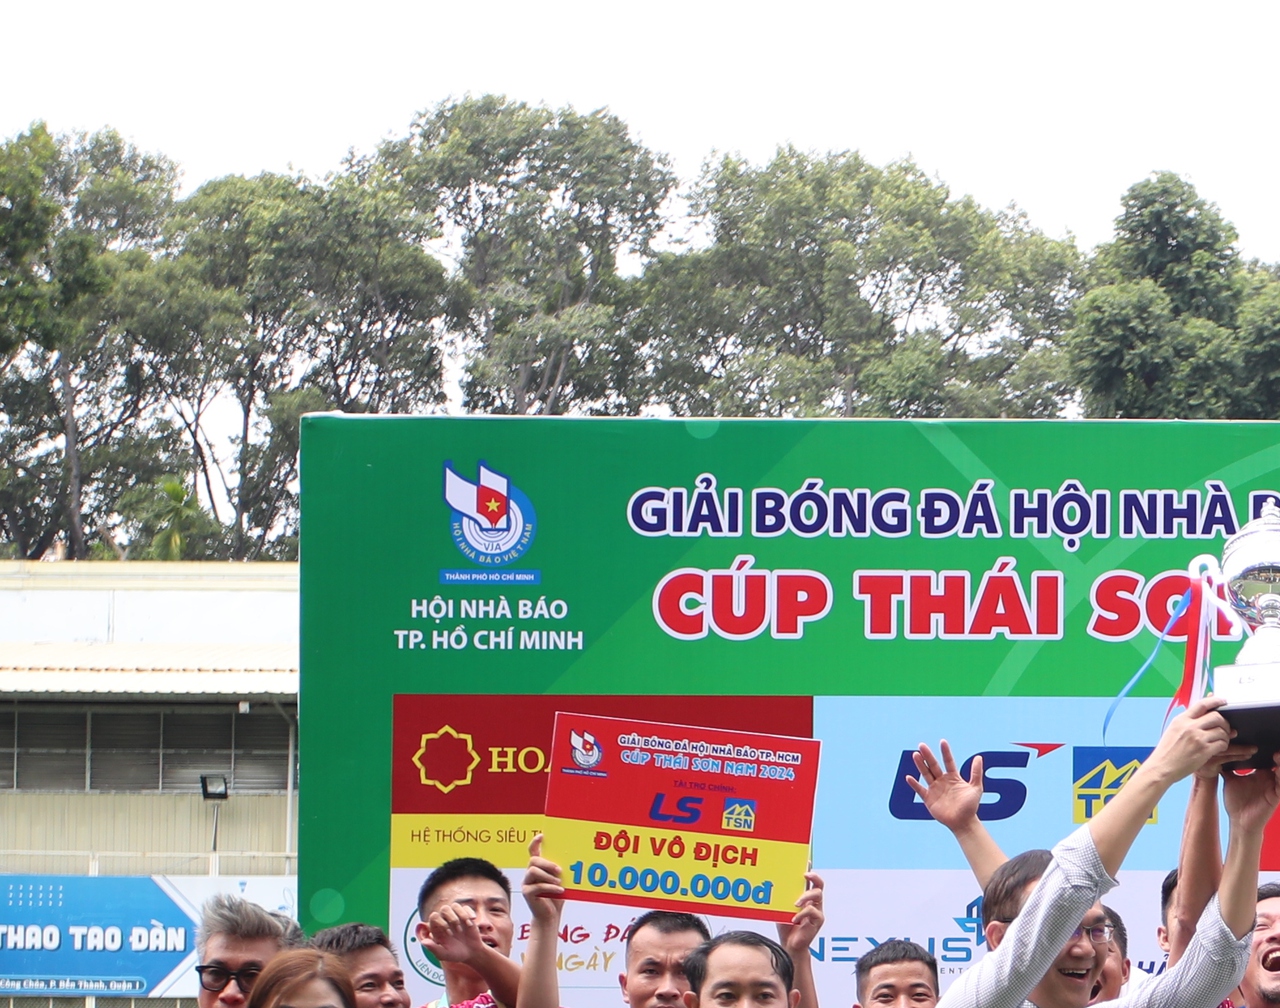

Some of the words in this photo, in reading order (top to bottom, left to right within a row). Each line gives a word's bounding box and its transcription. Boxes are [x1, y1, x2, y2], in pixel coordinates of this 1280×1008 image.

[627, 473, 742, 537] GIẢI
[753, 480, 911, 537] BÓNG
[918, 478, 1004, 538] ĐÁ
[1010, 480, 1110, 552] HỘI
[1119, 480, 1242, 539] NHÀ
[483, 542, 502, 551] VJA
[445, 571, 471, 581] THÀNH
[515, 573, 534, 581] MINH
[411, 595, 454, 624] HỘI
[461, 595, 512, 619] NHÀ
[518, 596, 568, 619] BÁO
[652, 553, 833, 642] CÚP
[855, 556, 1063, 642] THÁI
[393, 630, 426, 650] TP.
[432, 624, 468, 650] HỒ
[473, 627, 514, 650] CHÍ
[519, 631, 584, 650] MINH
[617, 733, 642, 747] GIẢI
[643, 736, 671, 751] BÓNG
[674, 739, 690, 752] ĐÁ
[691, 741, 711, 756] HỘI
[711, 744, 734, 757] NHÀ
[735, 746, 758, 760] BÁO
[759, 749, 776, 762] TP.
[777, 752, 802, 765] HCM
[620, 748, 651, 766] CÚP
[655, 752, 690, 771] THÁI
[692, 756, 723, 774] SƠN
[724, 761, 758, 778] NAM
[759, 764, 796, 781] 2024
[648, 792, 705, 825] LS
[724, 816, 753, 830] TSN
[410, 827, 431, 845] HỆ
[435, 827, 493, 844] THỐNG
[496, 827, 527, 844] SIÊU
[594, 829, 640, 857] ĐỘI
[649, 835, 686, 859] VÔ
[693, 842, 759, 868] ĐỊCH
[569, 860, 774, 905] 10.000.000đ
[0, 924, 61, 950] THAO
[69, 925, 123, 952] TAO
[129, 918, 187, 952] ĐÀN
[518, 923, 591, 944] BNG
